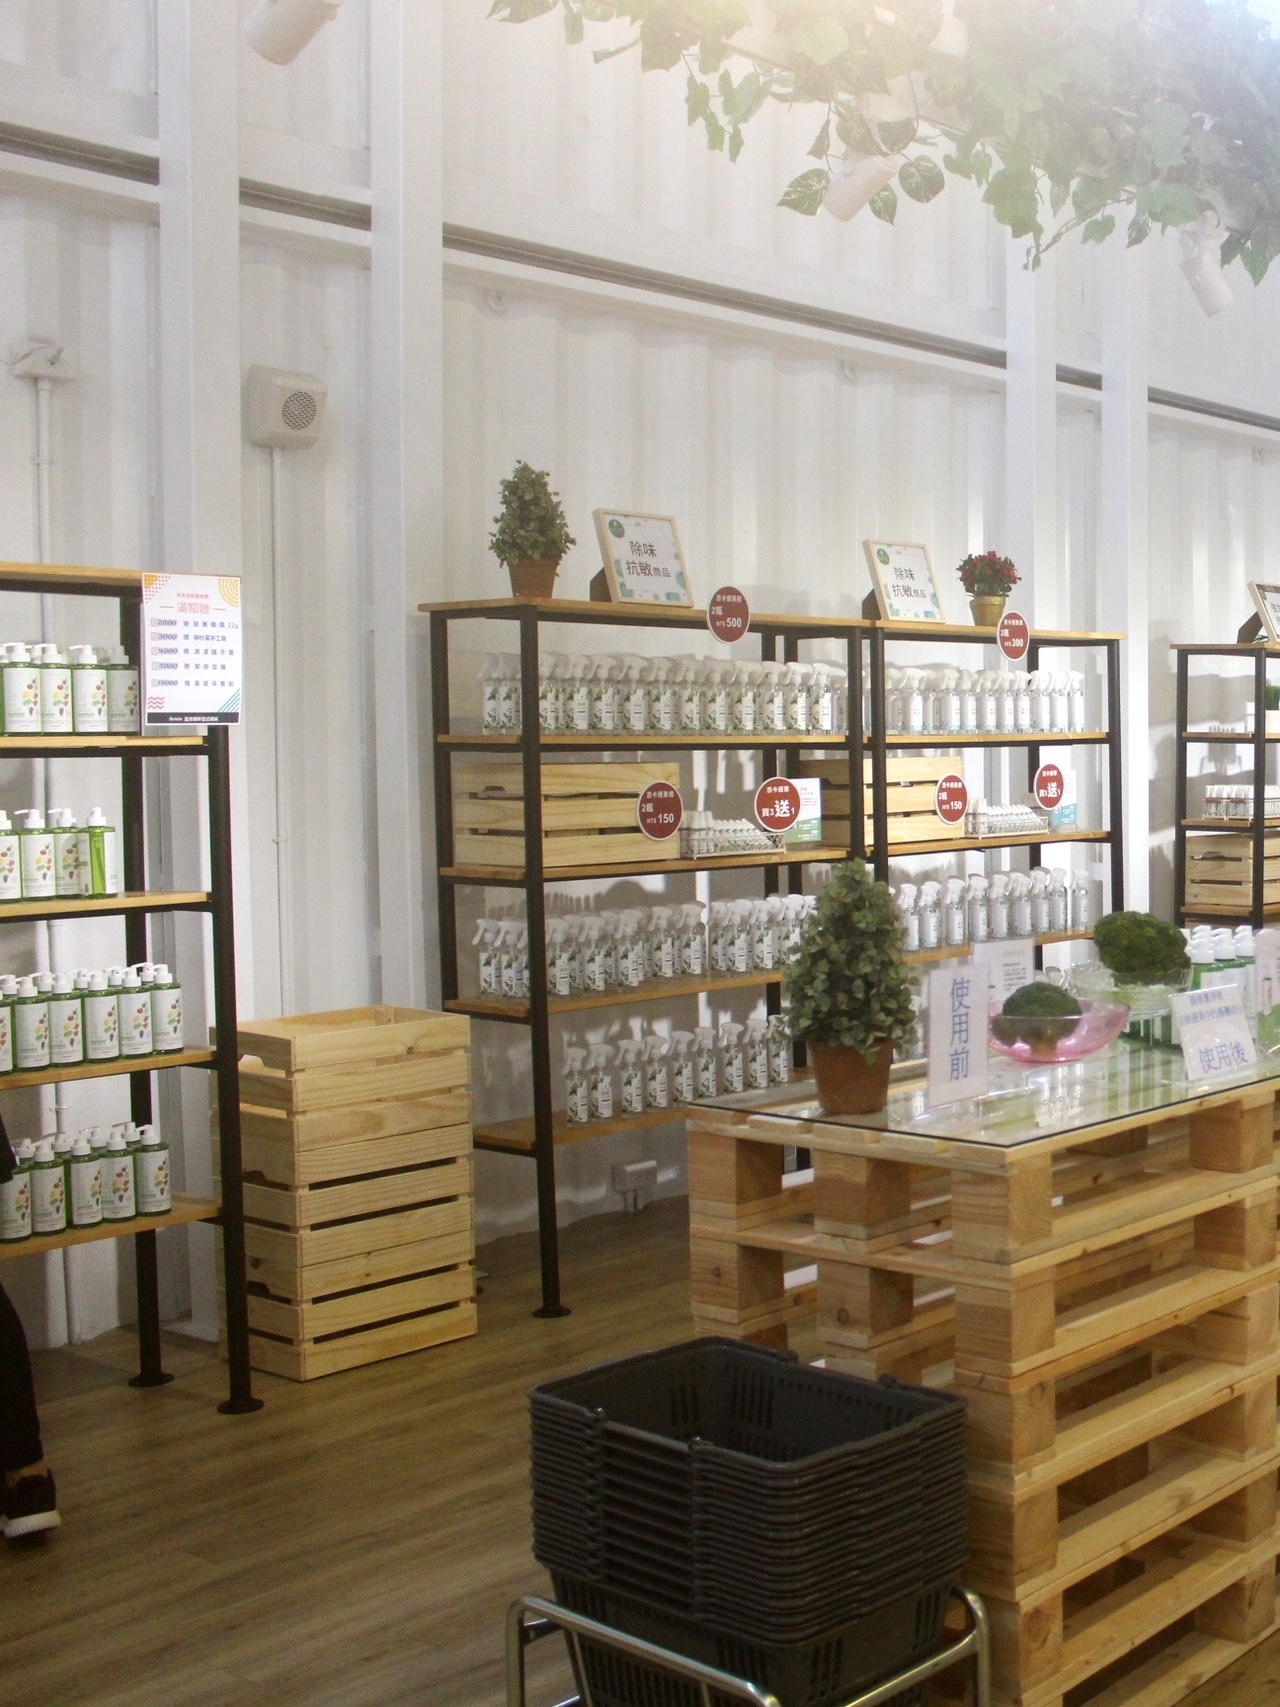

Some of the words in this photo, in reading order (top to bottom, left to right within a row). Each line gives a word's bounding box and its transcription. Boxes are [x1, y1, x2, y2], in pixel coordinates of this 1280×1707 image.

[630, 541, 657, 558] 除味
[893, 567, 916, 581] 除味
[726, 618, 742, 628] 500
[1012, 638, 1024, 648] 300
[950, 801, 962, 810] 150
[658, 813, 674, 824] 150
[950, 978, 970, 1082] 使用前
[1199, 1041, 1248, 1074] 使用後
